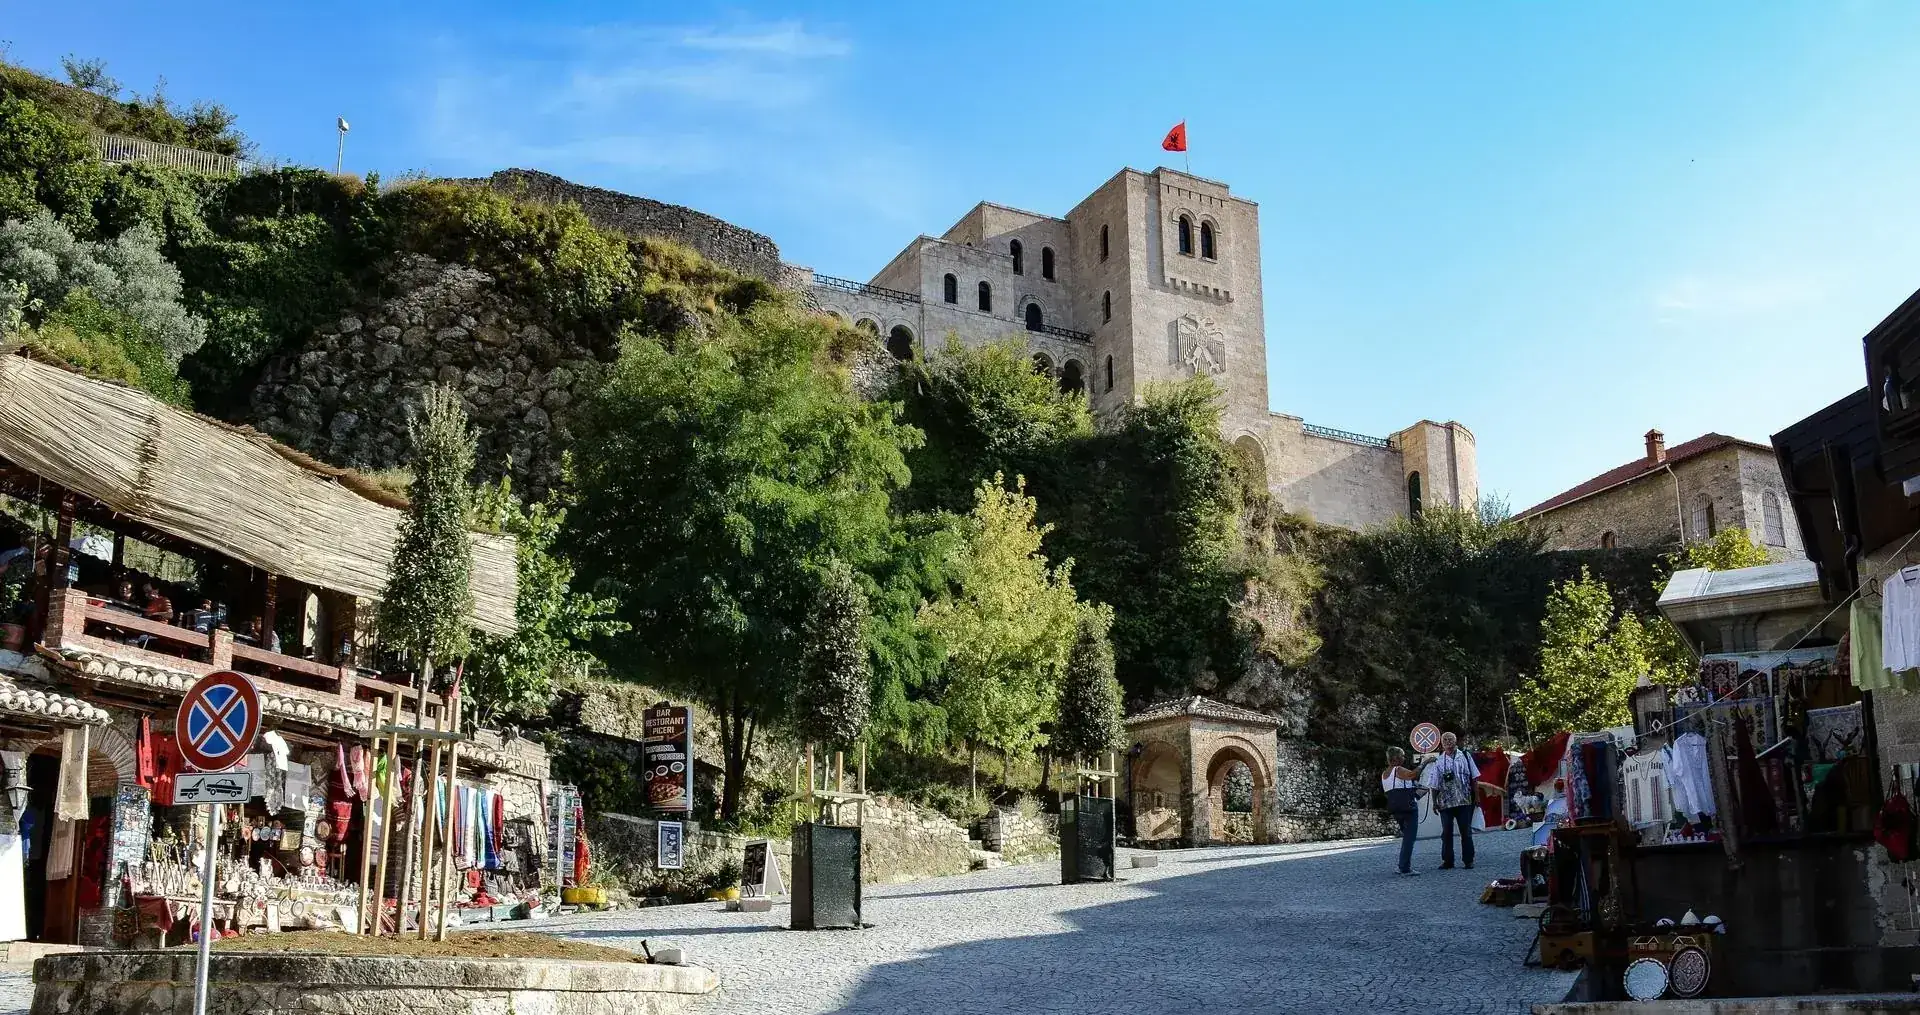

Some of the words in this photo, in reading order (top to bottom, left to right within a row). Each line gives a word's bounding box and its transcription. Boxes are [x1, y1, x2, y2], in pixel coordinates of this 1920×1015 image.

[656, 708, 671, 717] BAR
[645, 716, 685, 727] RESTORANT
[652, 726, 675, 735] PICERI
[499, 737, 523, 758] BAR
